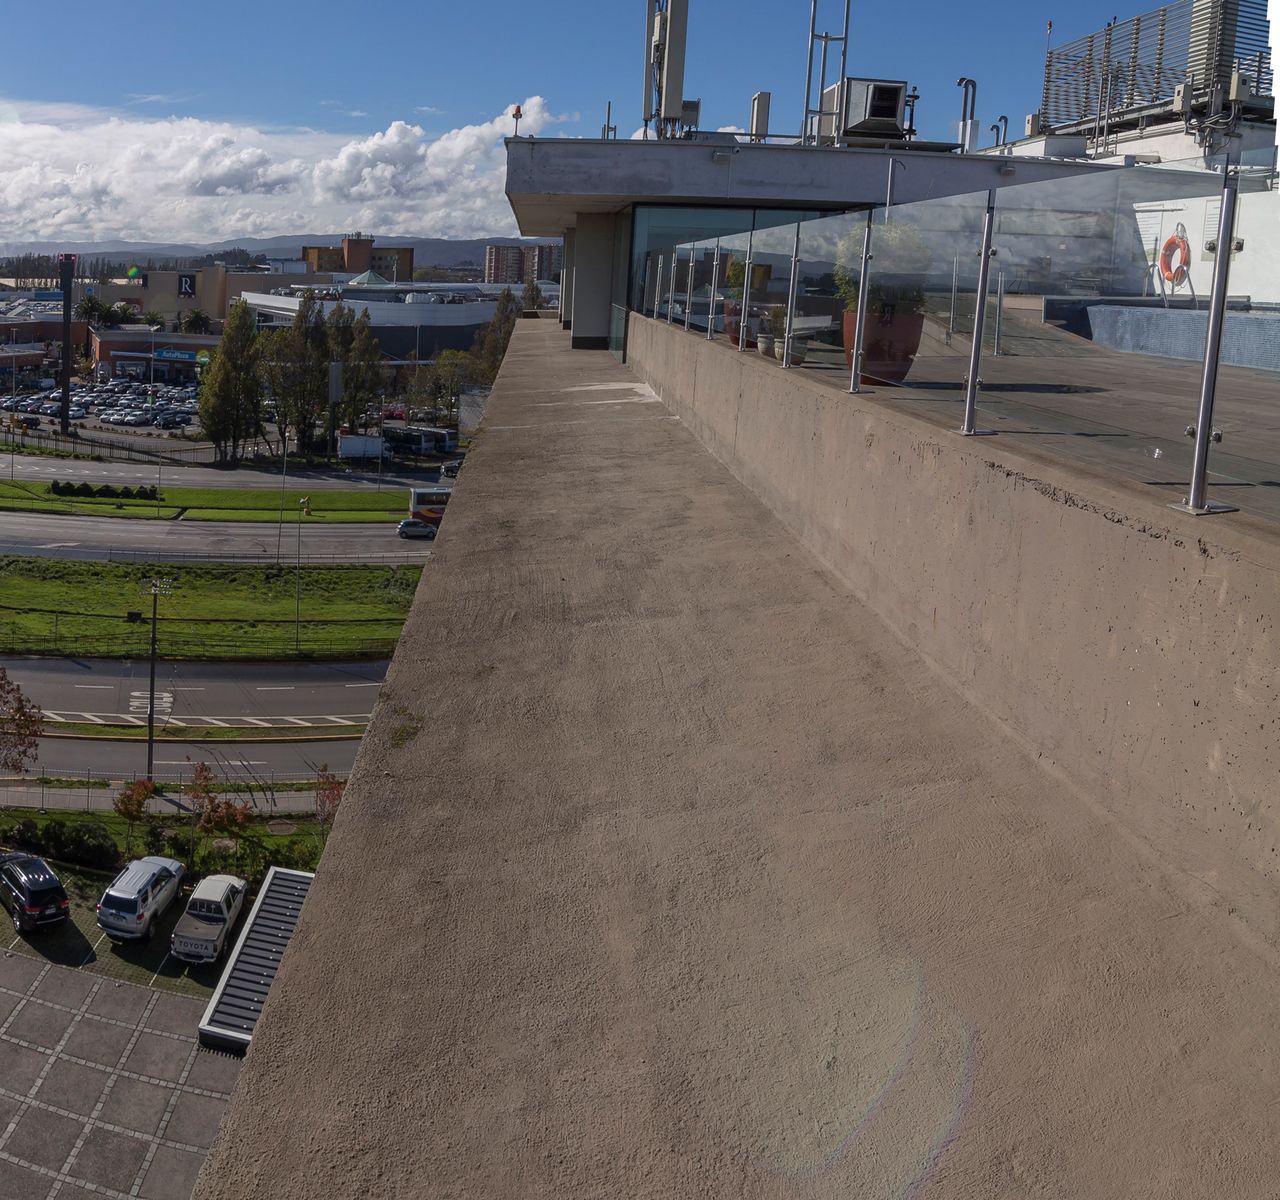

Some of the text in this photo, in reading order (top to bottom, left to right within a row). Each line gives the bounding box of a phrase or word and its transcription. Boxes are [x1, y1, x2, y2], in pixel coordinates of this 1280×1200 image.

[181, 277, 192, 293] R
[129, 691, 173, 712] SOLO
[179, 940, 209, 951] TOYOTA
